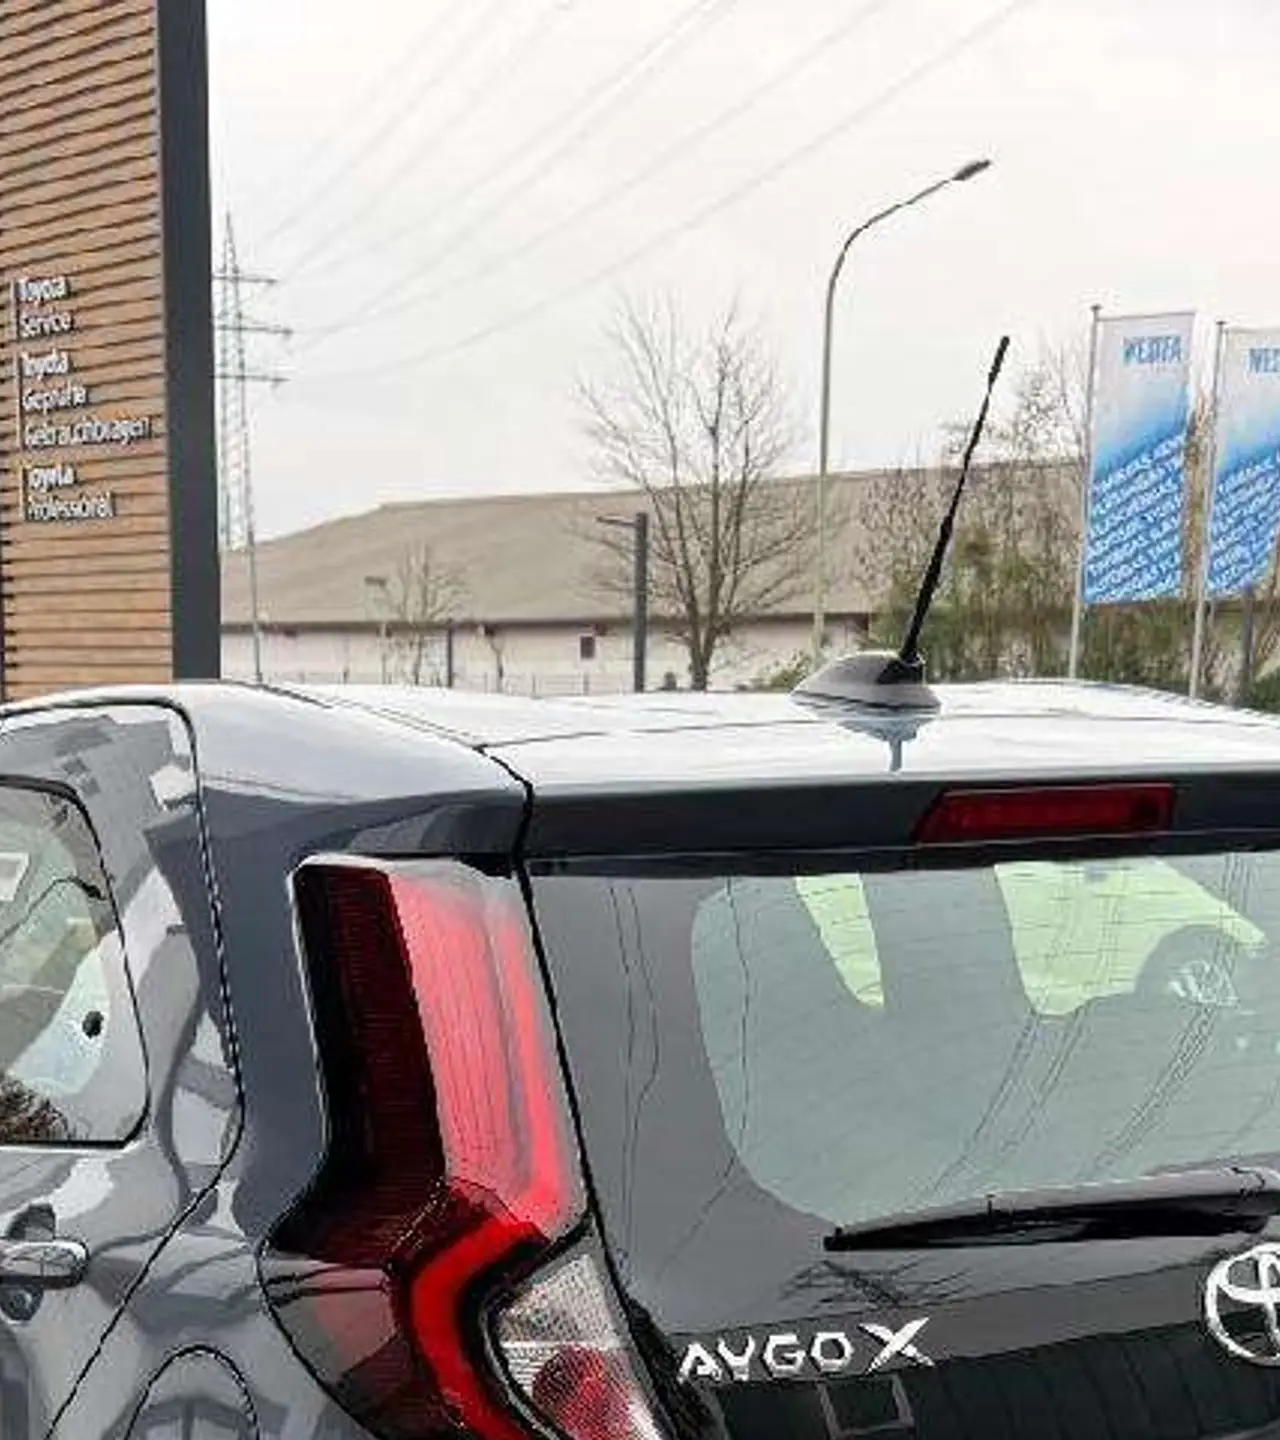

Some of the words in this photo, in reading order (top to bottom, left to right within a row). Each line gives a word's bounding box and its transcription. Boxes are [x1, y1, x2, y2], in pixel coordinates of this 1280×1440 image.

[19, 276, 67, 305] Toyota
[20, 311, 72, 338] Service
[21, 350, 69, 380] Toyota
[24, 462, 74, 493] Toyota
[676, 1331, 855, 1383] AYGO
[859, 1316, 936, 1376] X
